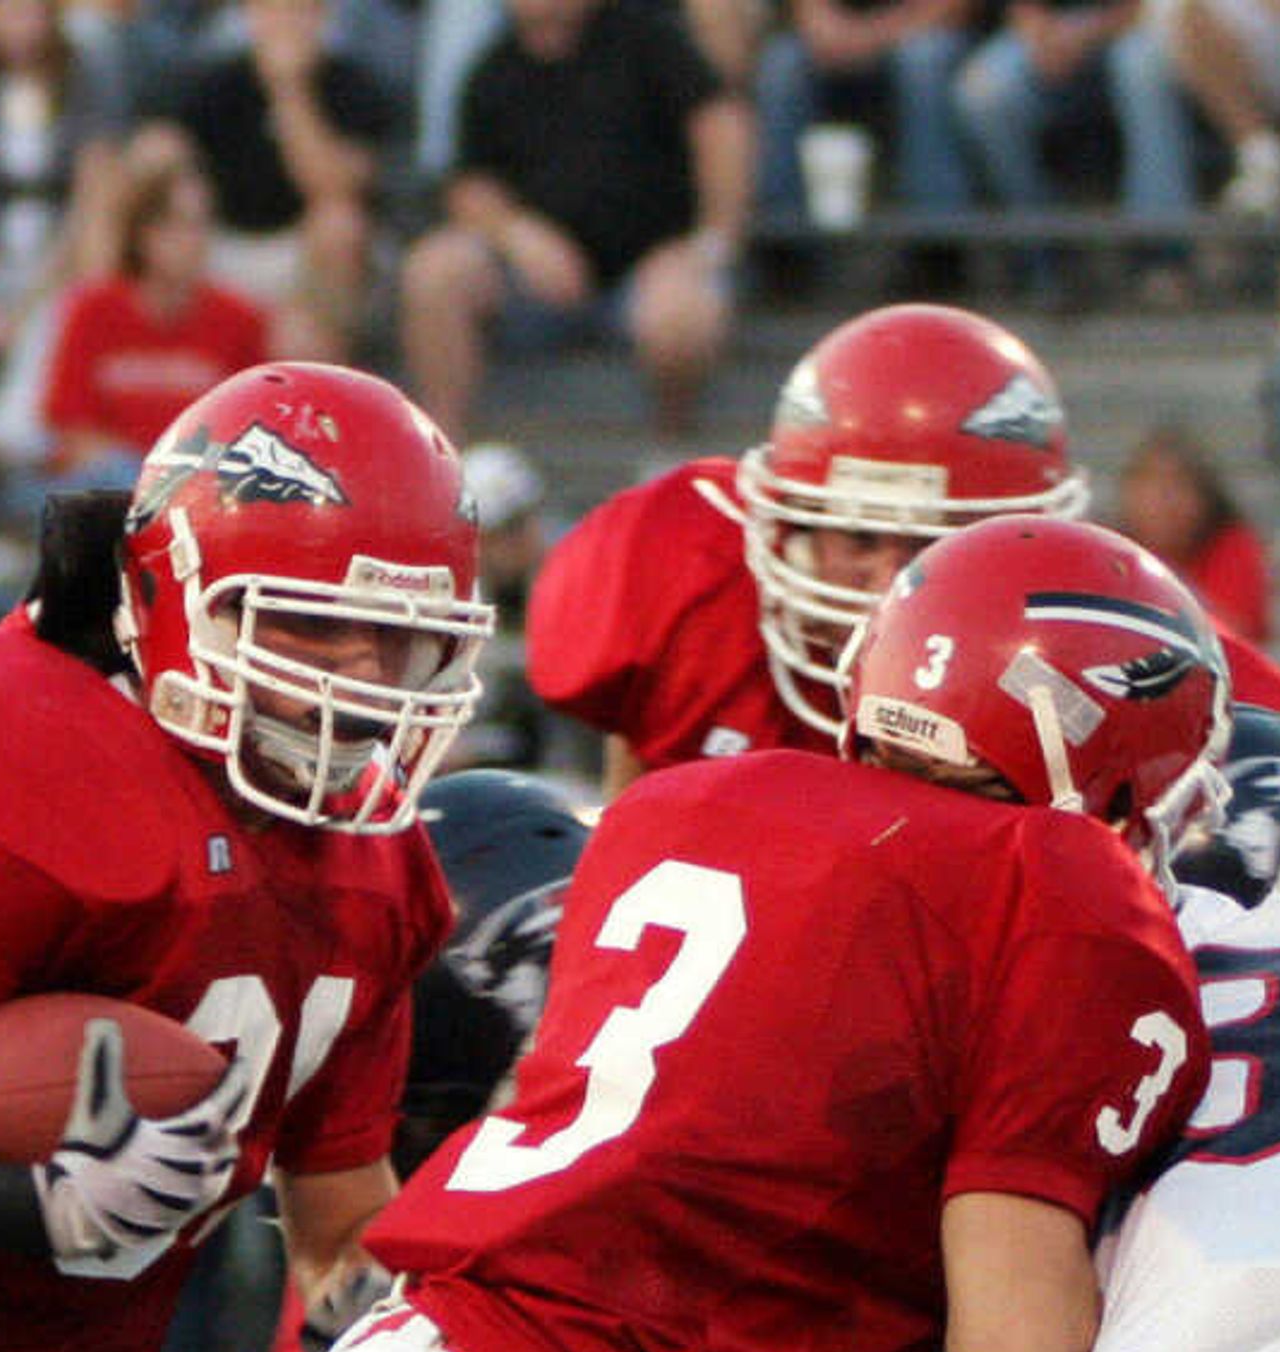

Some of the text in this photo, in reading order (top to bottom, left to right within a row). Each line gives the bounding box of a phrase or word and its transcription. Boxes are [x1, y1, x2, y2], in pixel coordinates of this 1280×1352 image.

[914, 633, 954, 689] 3
[443, 858, 748, 1192] 3
[1095, 1010, 1187, 1156] 3
